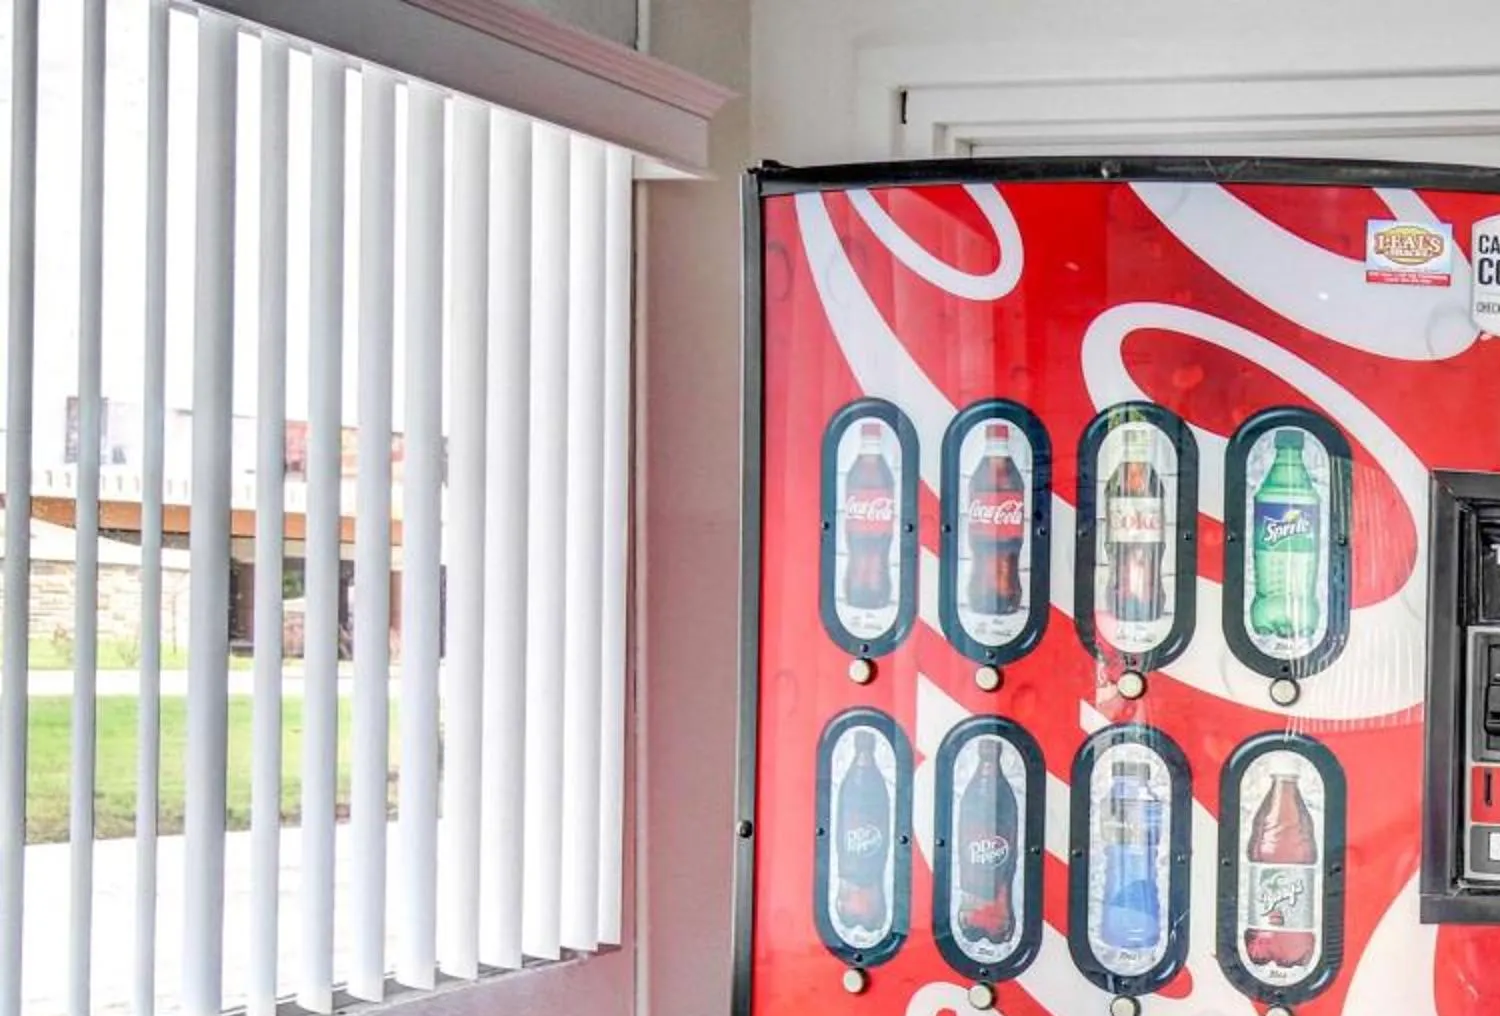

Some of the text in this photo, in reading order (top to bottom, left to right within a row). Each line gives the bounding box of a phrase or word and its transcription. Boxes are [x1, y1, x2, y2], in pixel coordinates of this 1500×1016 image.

[846, 495, 894, 522] Coca-Cola
[968, 499, 1024, 526] Coca-Cola
[1264, 513, 1313, 543] Sprite
